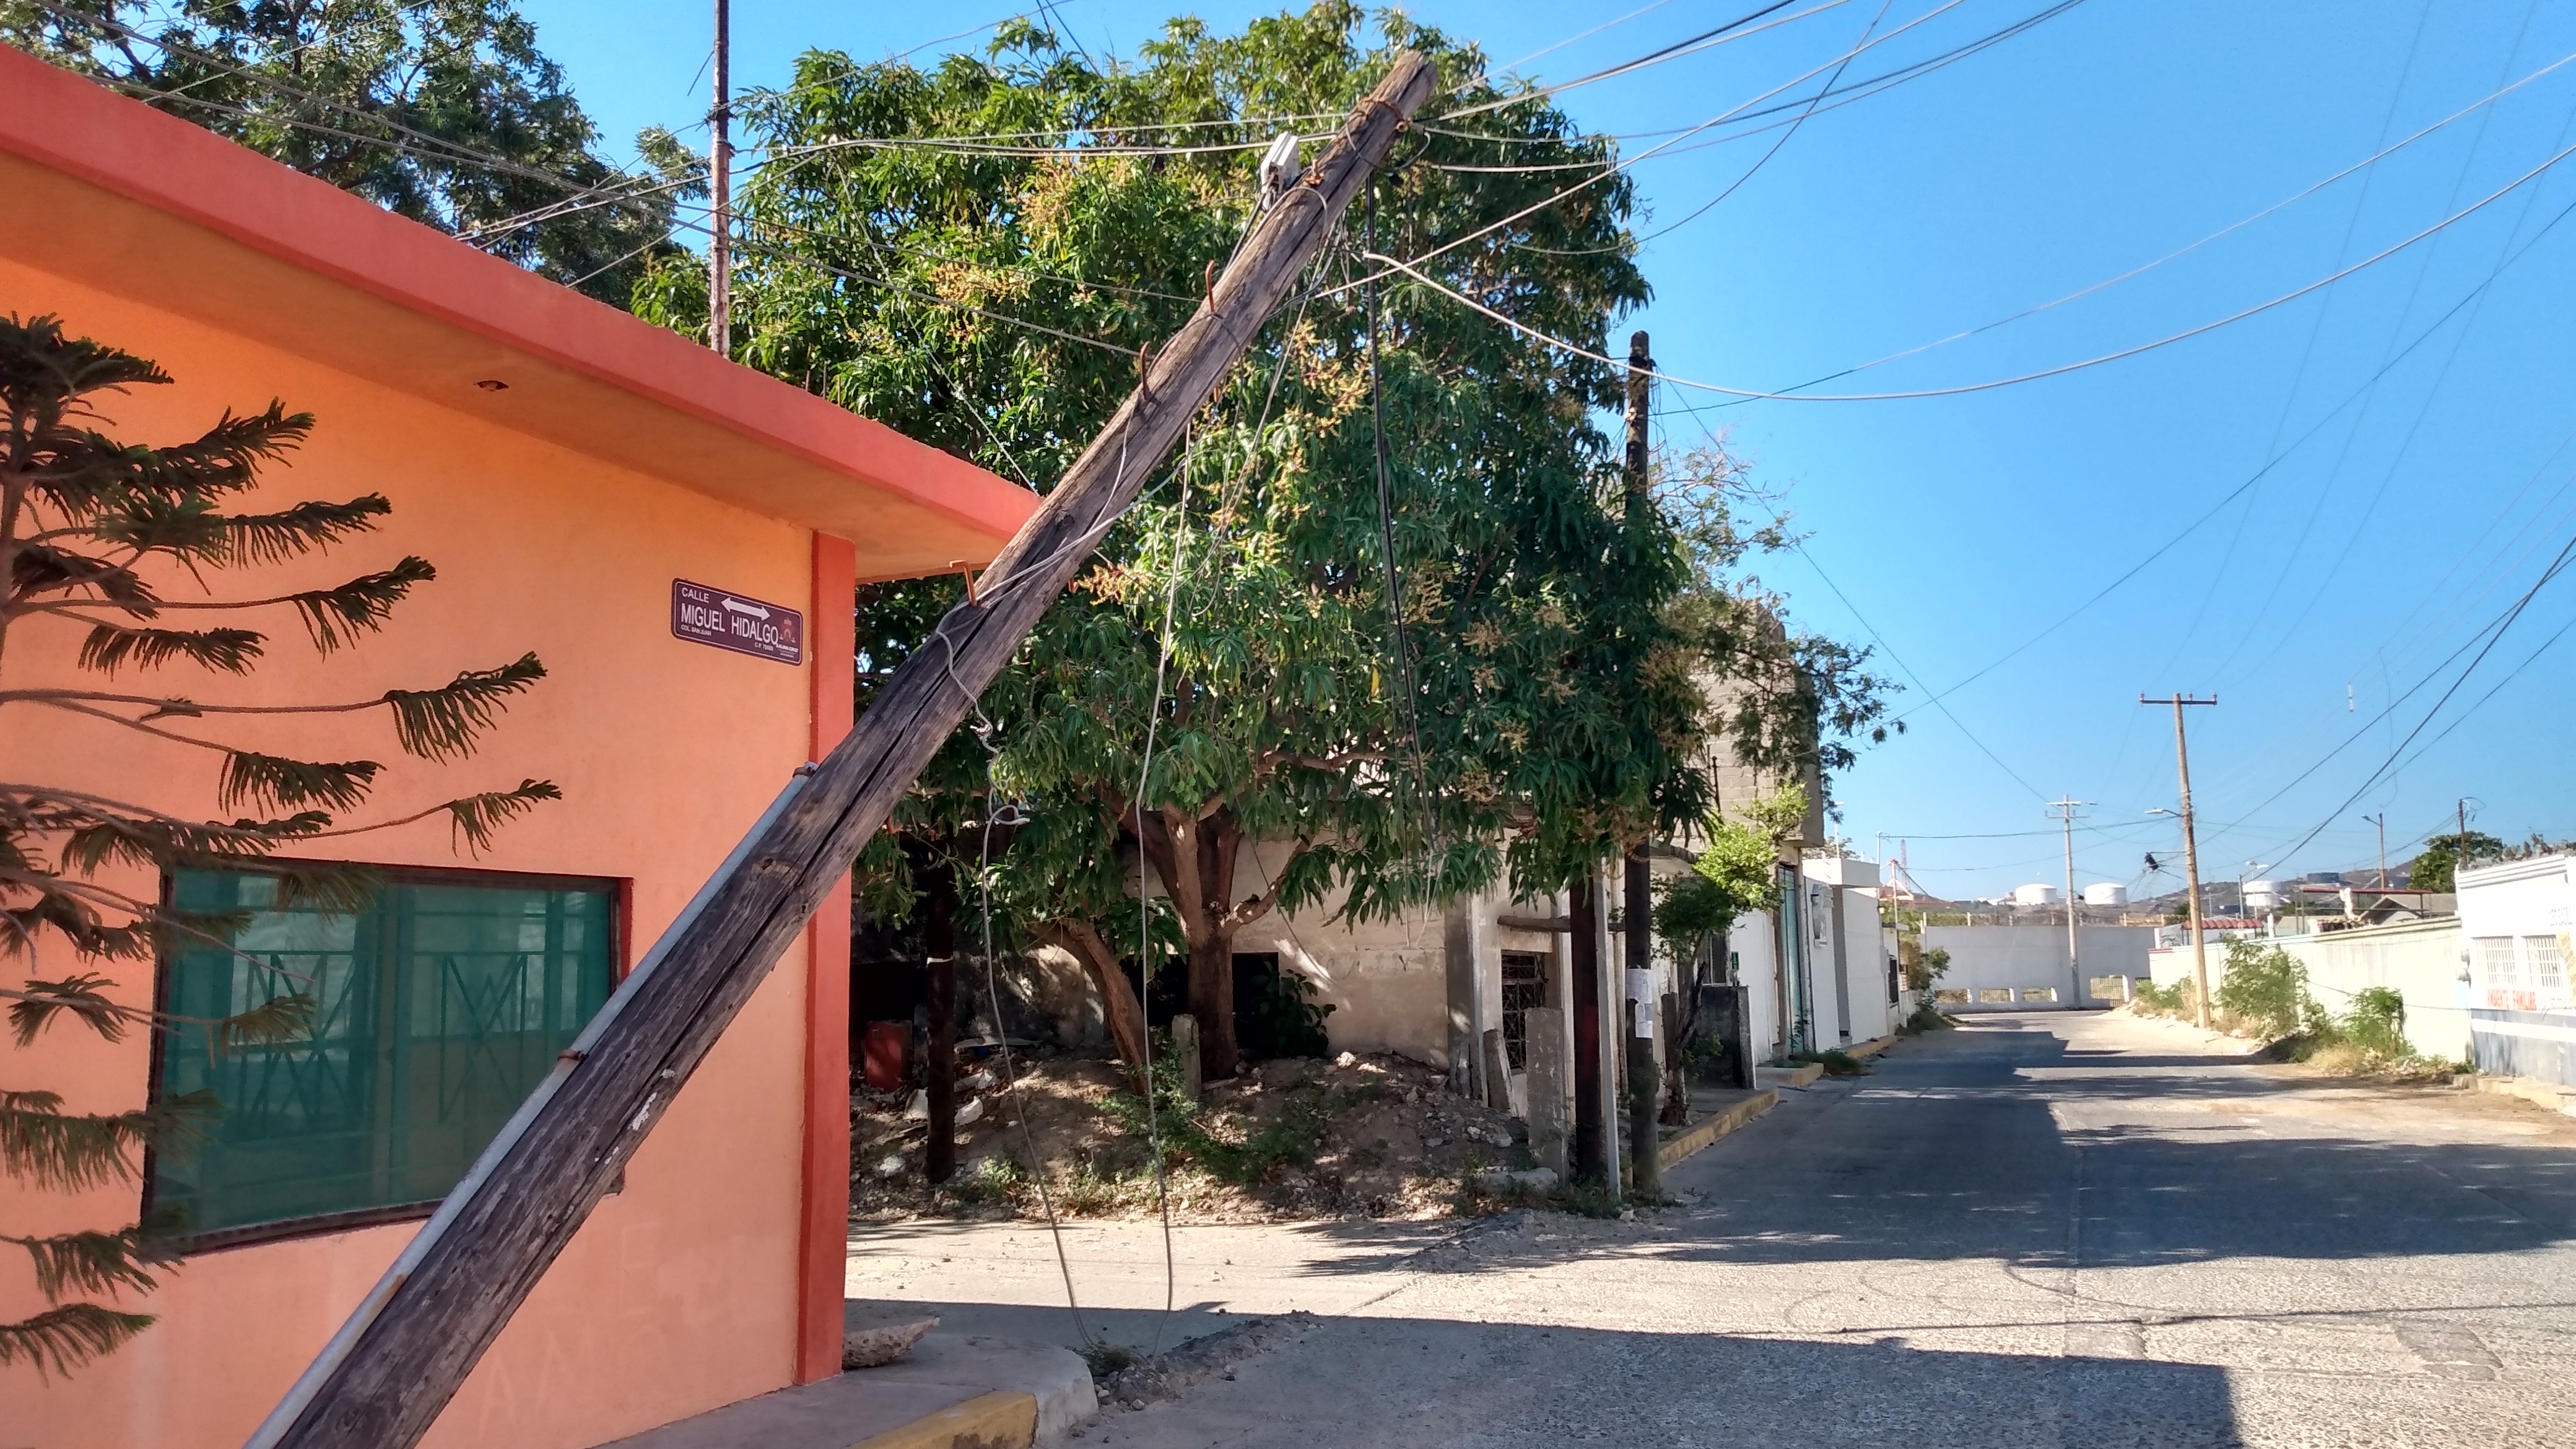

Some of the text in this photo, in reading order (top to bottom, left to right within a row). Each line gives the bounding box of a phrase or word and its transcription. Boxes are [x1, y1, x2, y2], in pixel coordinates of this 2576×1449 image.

[682, 588, 710, 604] CALLE
[681, 603, 778, 645] MIGUEL HIDALGO
[2513, 990, 2536, 1011] FAMILIAR
